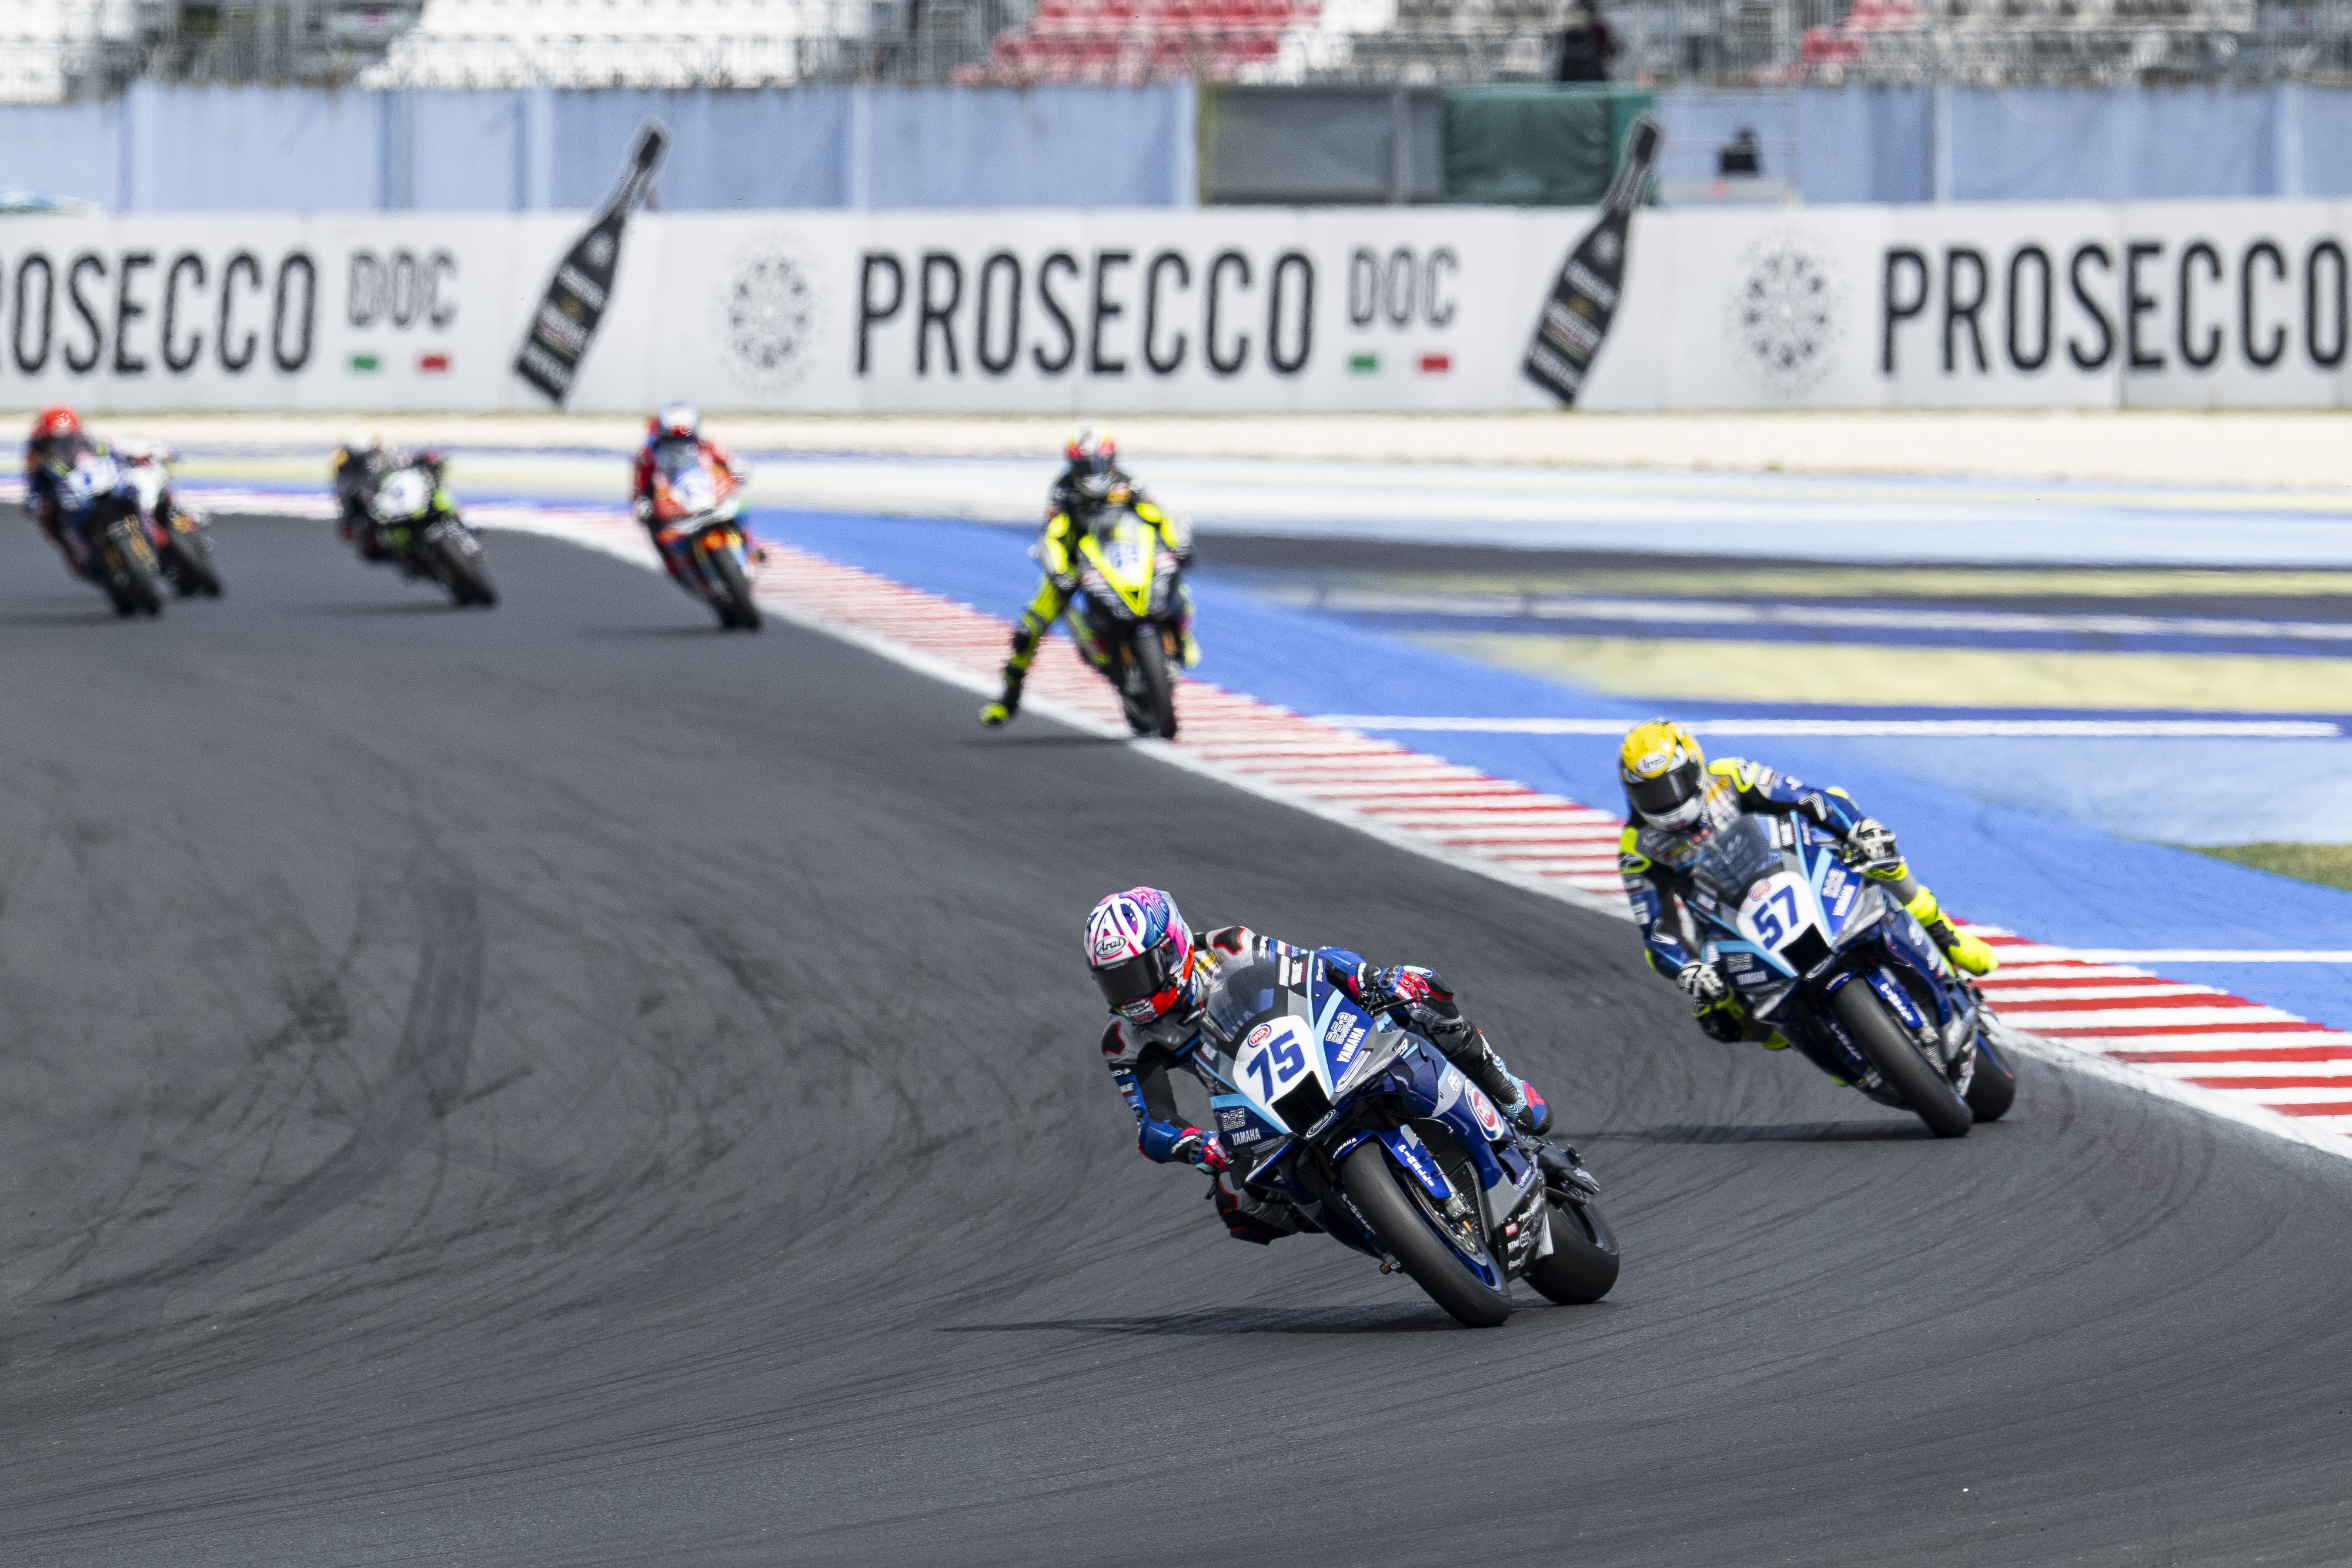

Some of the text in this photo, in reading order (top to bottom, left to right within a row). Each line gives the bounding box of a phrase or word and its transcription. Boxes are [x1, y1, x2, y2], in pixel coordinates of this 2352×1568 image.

[0, 252, 318, 376] OSECCO
[348, 250, 458, 328] DOC
[855, 249, 1317, 376] PROSECCO
[1348, 248, 1457, 328] DOC
[1880, 241, 2350, 375] PROSECCO
[1752, 885, 1799, 951] 57
[1096, 937, 1122, 954] Arai
[1251, 1029, 1268, 1044] PATA
[1337, 1015, 1358, 1045] SANTERO
[1337, 1027, 1366, 1063] YAMAHA
[1246, 1029, 1305, 1105] 75
[1223, 1120, 1245, 1132] SANTERO
[1232, 1128, 1261, 1146] YAMAHA
[1332, 1138, 1357, 1159] YAMAHA
[1398, 1144, 1435, 1187] PIRELLI
